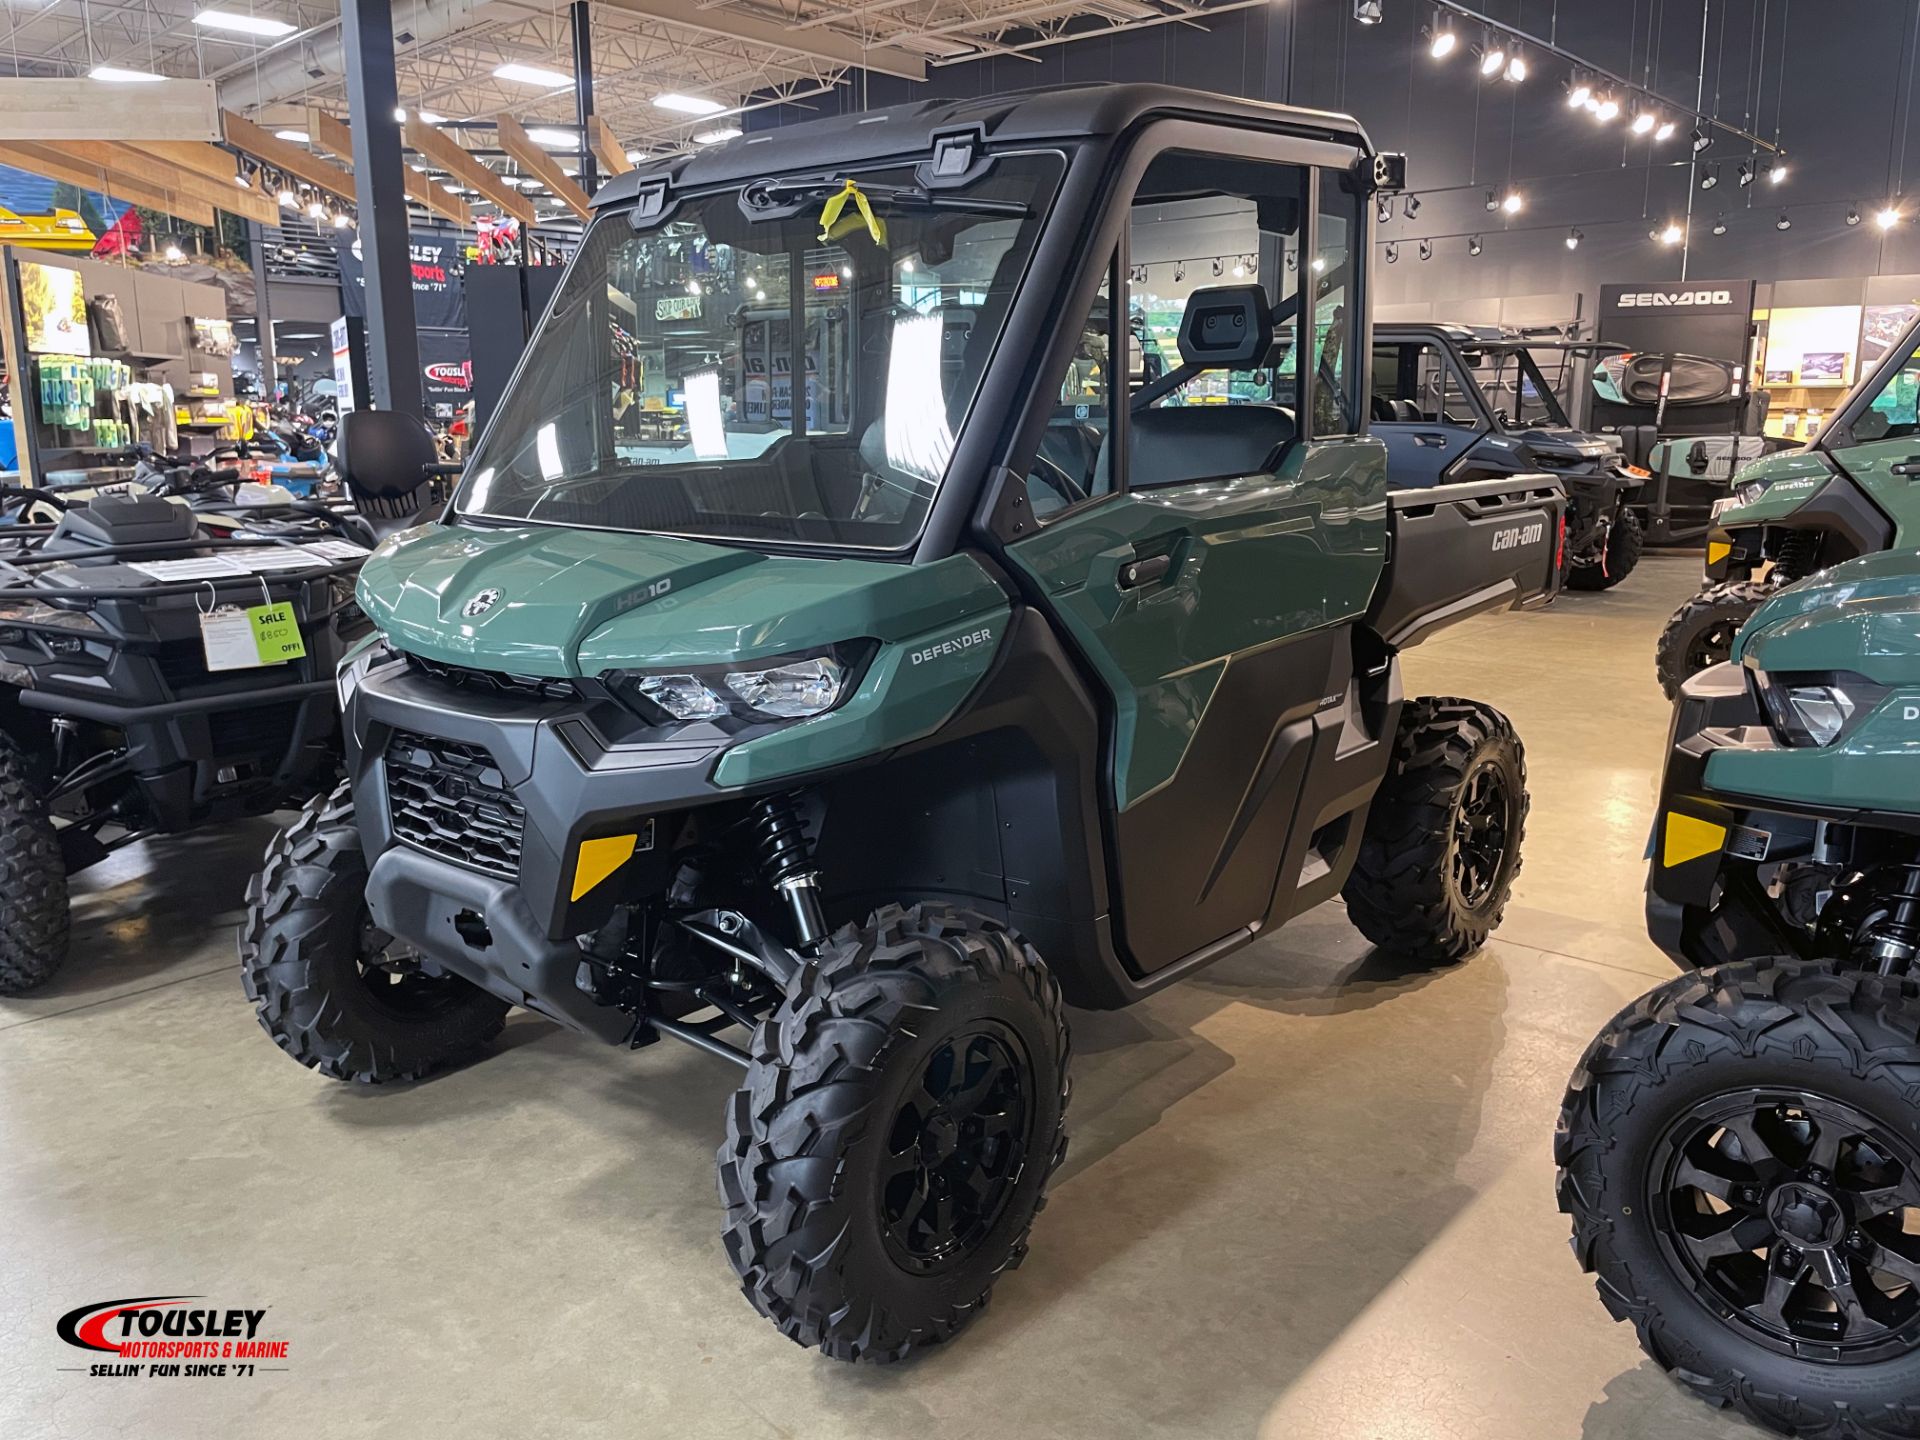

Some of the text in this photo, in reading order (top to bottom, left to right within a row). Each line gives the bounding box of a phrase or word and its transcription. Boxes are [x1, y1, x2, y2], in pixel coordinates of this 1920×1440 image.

[1774, 481, 1814, 491] DEFENDER
[1491, 523, 1543, 552] can-am
[615, 578, 671, 611] HD10
[258, 612, 287, 625] SALE
[911, 628, 992, 666] DEFENDER
